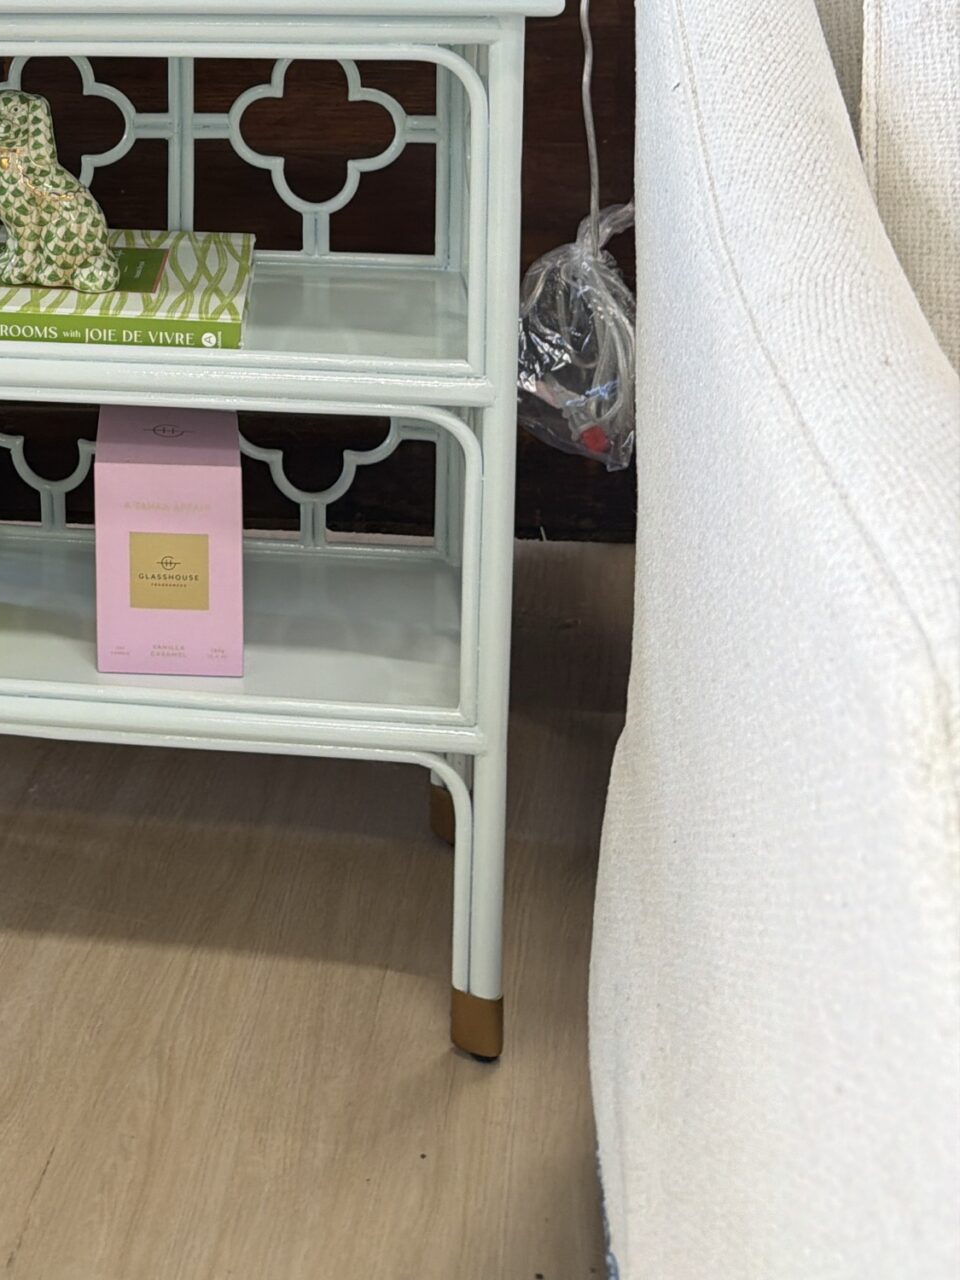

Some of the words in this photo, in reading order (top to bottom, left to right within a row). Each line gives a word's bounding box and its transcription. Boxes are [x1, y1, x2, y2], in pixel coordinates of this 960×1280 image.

[0, 324, 58, 339] ROOMS
[63, 329, 82, 339] with
[84, 327, 118, 343] JOIE
[122, 329, 143, 344] DE
[147, 331, 195, 346] VIVRE
[138, 572, 200, 582] GLASSHOUSE
